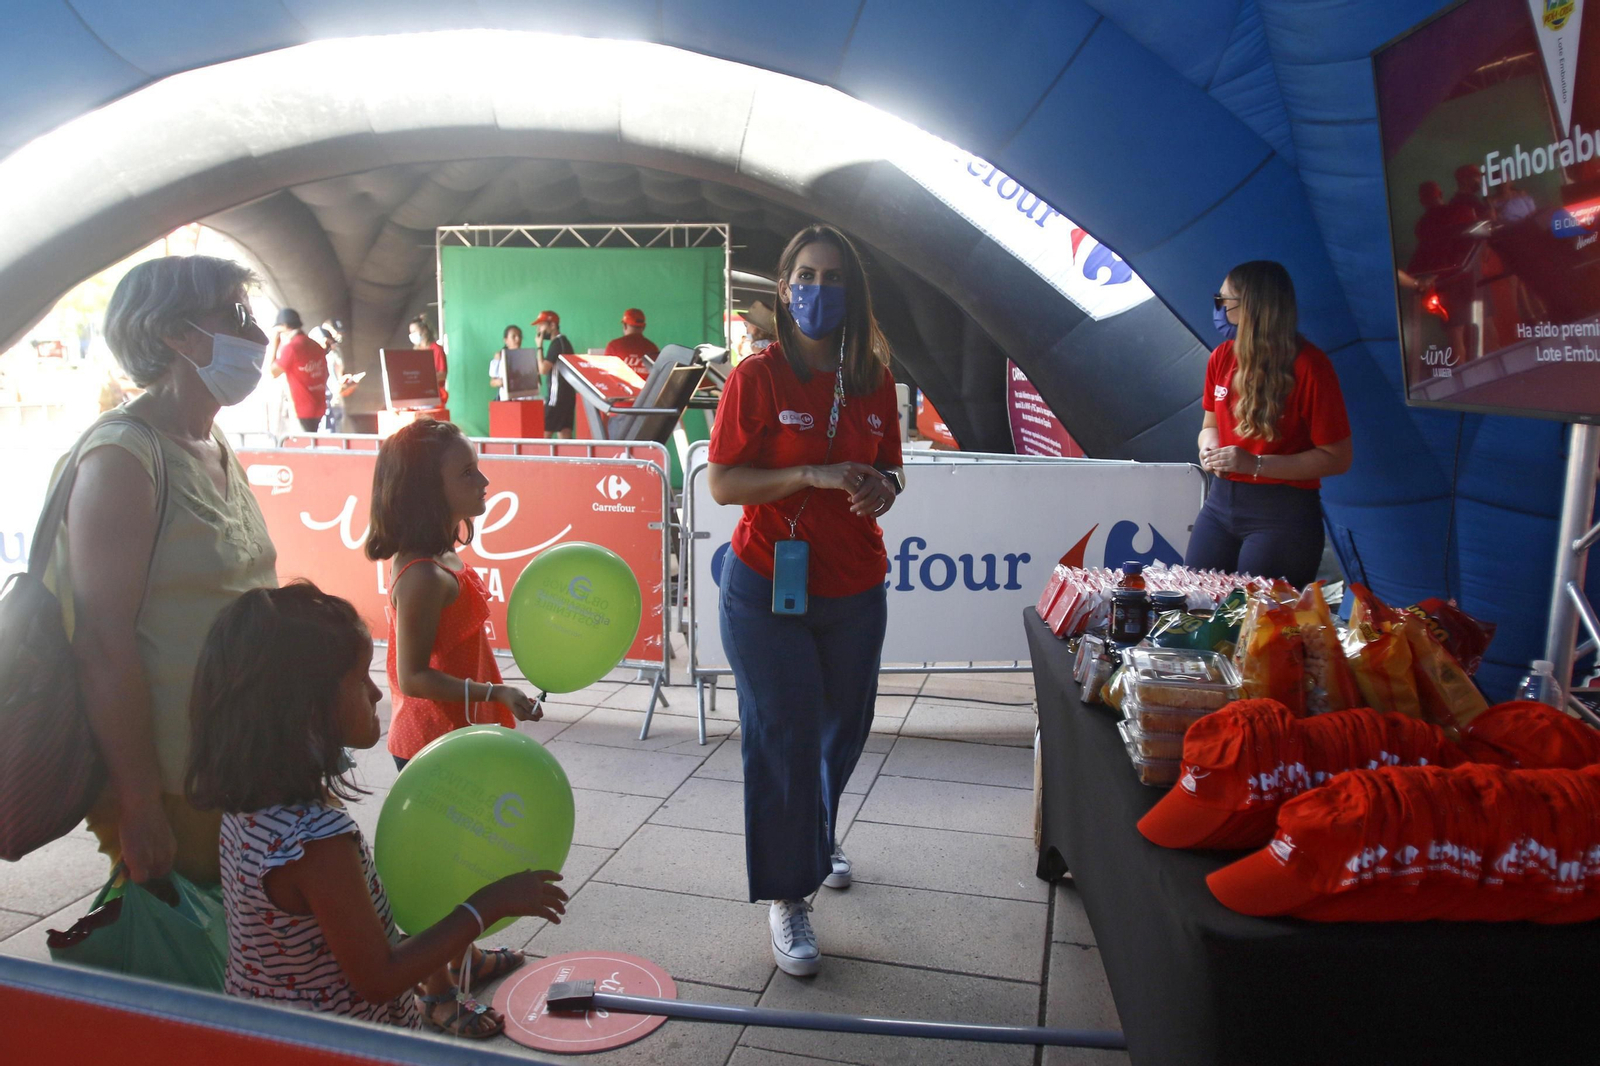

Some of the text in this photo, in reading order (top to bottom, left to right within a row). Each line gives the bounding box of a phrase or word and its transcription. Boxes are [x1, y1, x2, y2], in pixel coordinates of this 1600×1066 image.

[1517, 323, 1533, 338] Ha
[1534, 321, 1559, 338] sido
[1536, 346, 1562, 362] Lote
[592, 502, 636, 513] Carrefour
